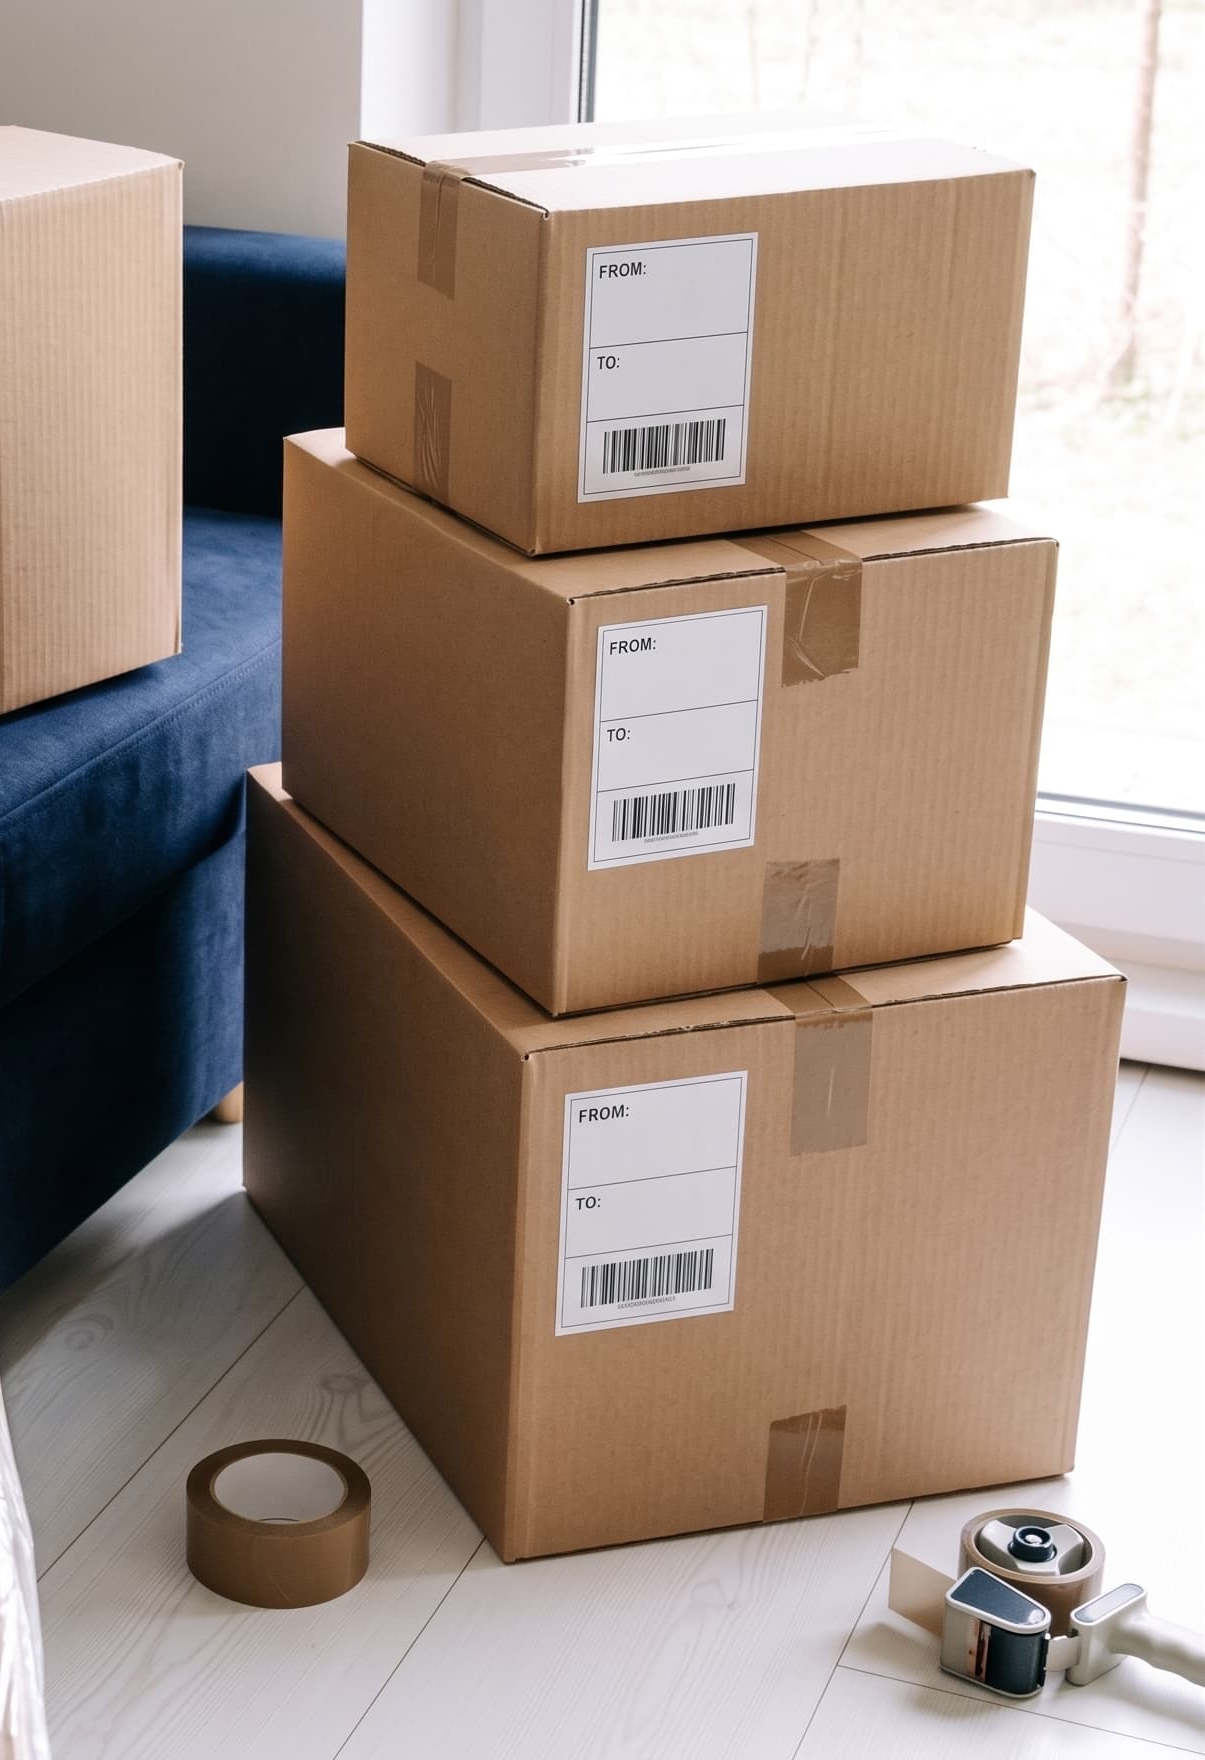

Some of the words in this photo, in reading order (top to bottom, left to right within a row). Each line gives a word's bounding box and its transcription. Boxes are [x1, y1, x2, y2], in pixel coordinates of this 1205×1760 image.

[599, 262, 646, 280] FROM:
[597, 356, 620, 370] TO:
[610, 637, 656, 655] FROM:
[607, 728, 630, 742] TO:
[579, 1104, 629, 1123] FROM:
[576, 1196, 601, 1210] TO:
